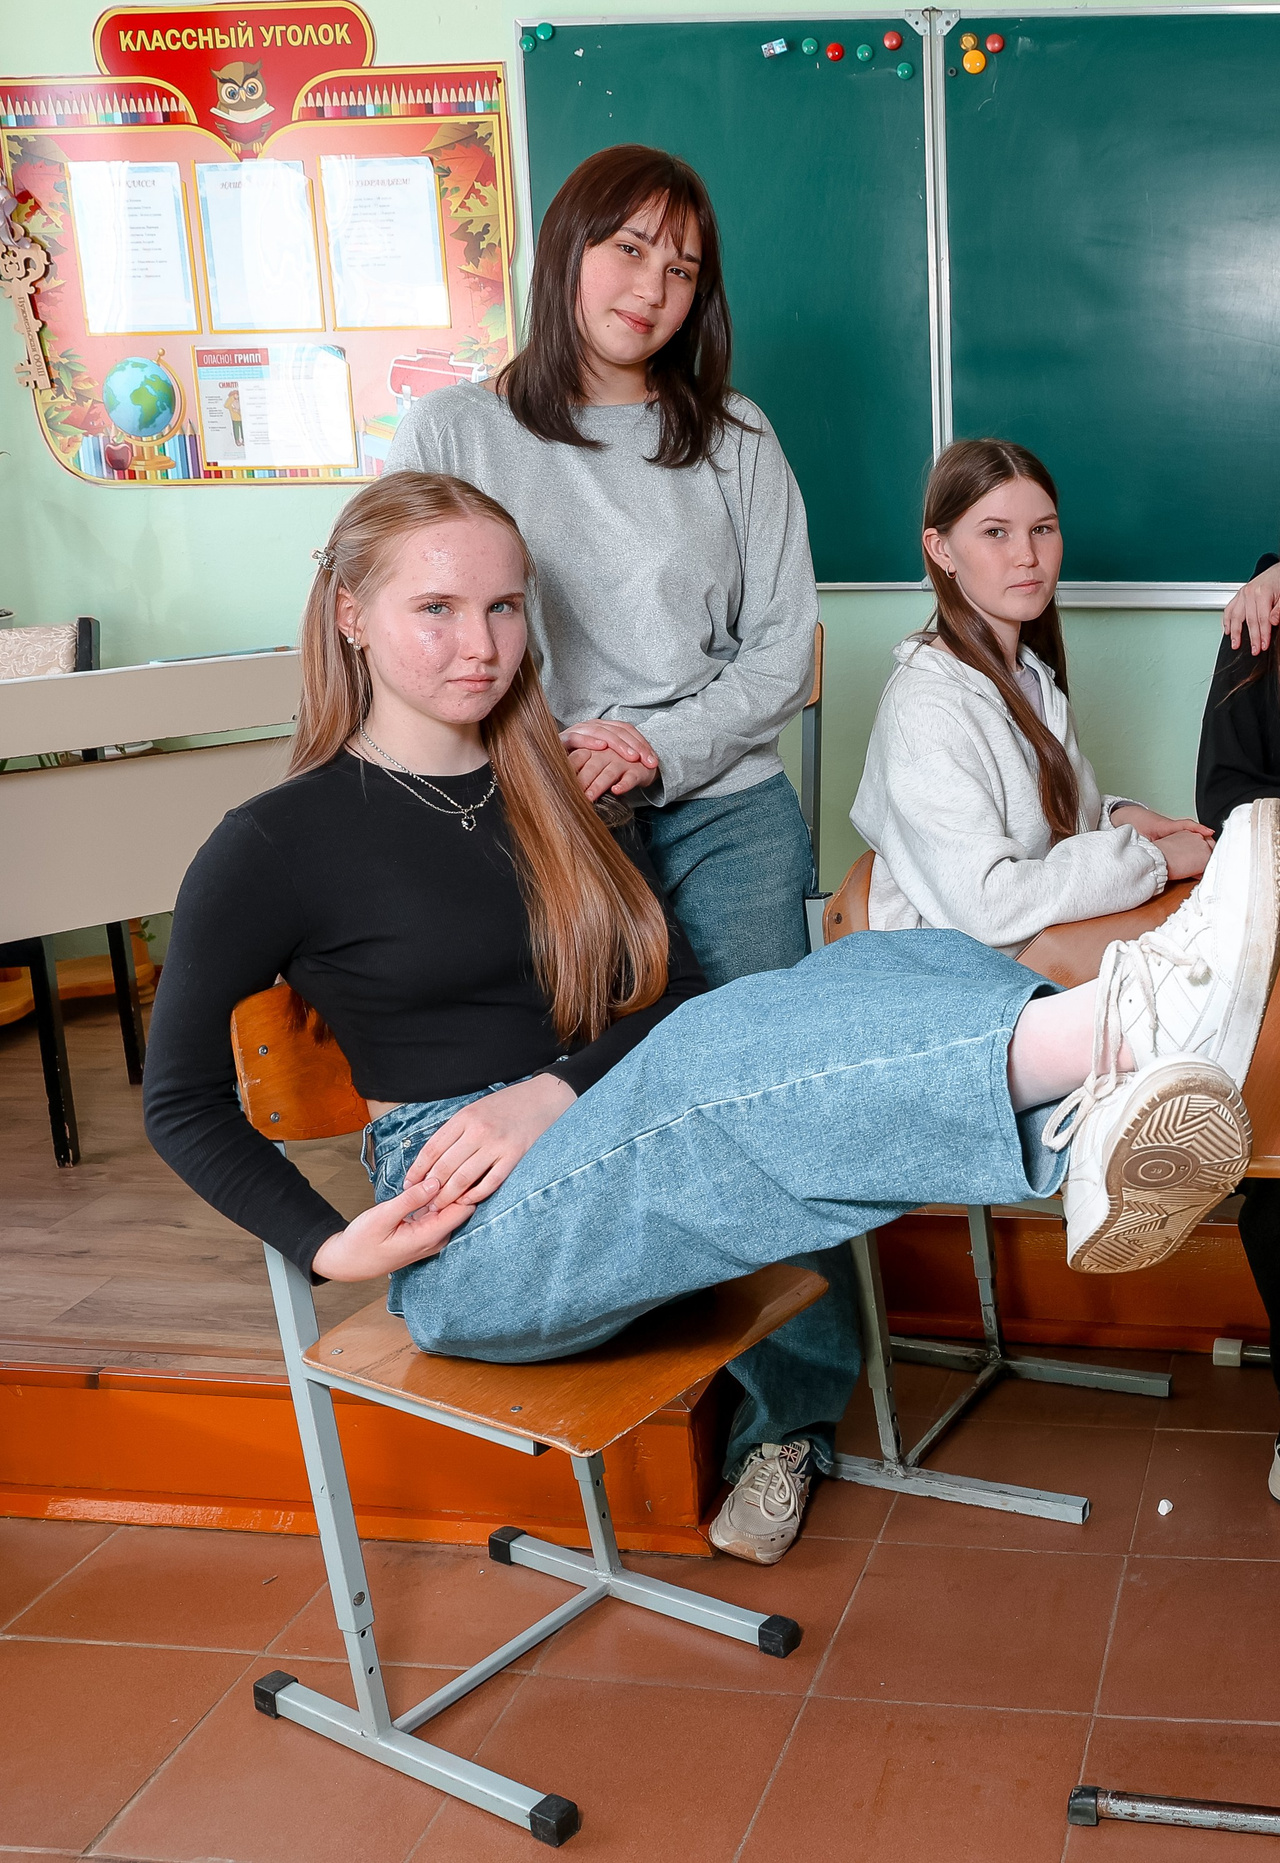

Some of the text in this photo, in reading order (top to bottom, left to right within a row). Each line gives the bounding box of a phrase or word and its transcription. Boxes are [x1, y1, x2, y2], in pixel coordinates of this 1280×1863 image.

[118, 20, 352, 52] КЛАССНЫЙ УГОЛОК
[33, 353, 46, 377] ООШ
[203, 353, 261, 365] ОПАСНО! ГРИПП
